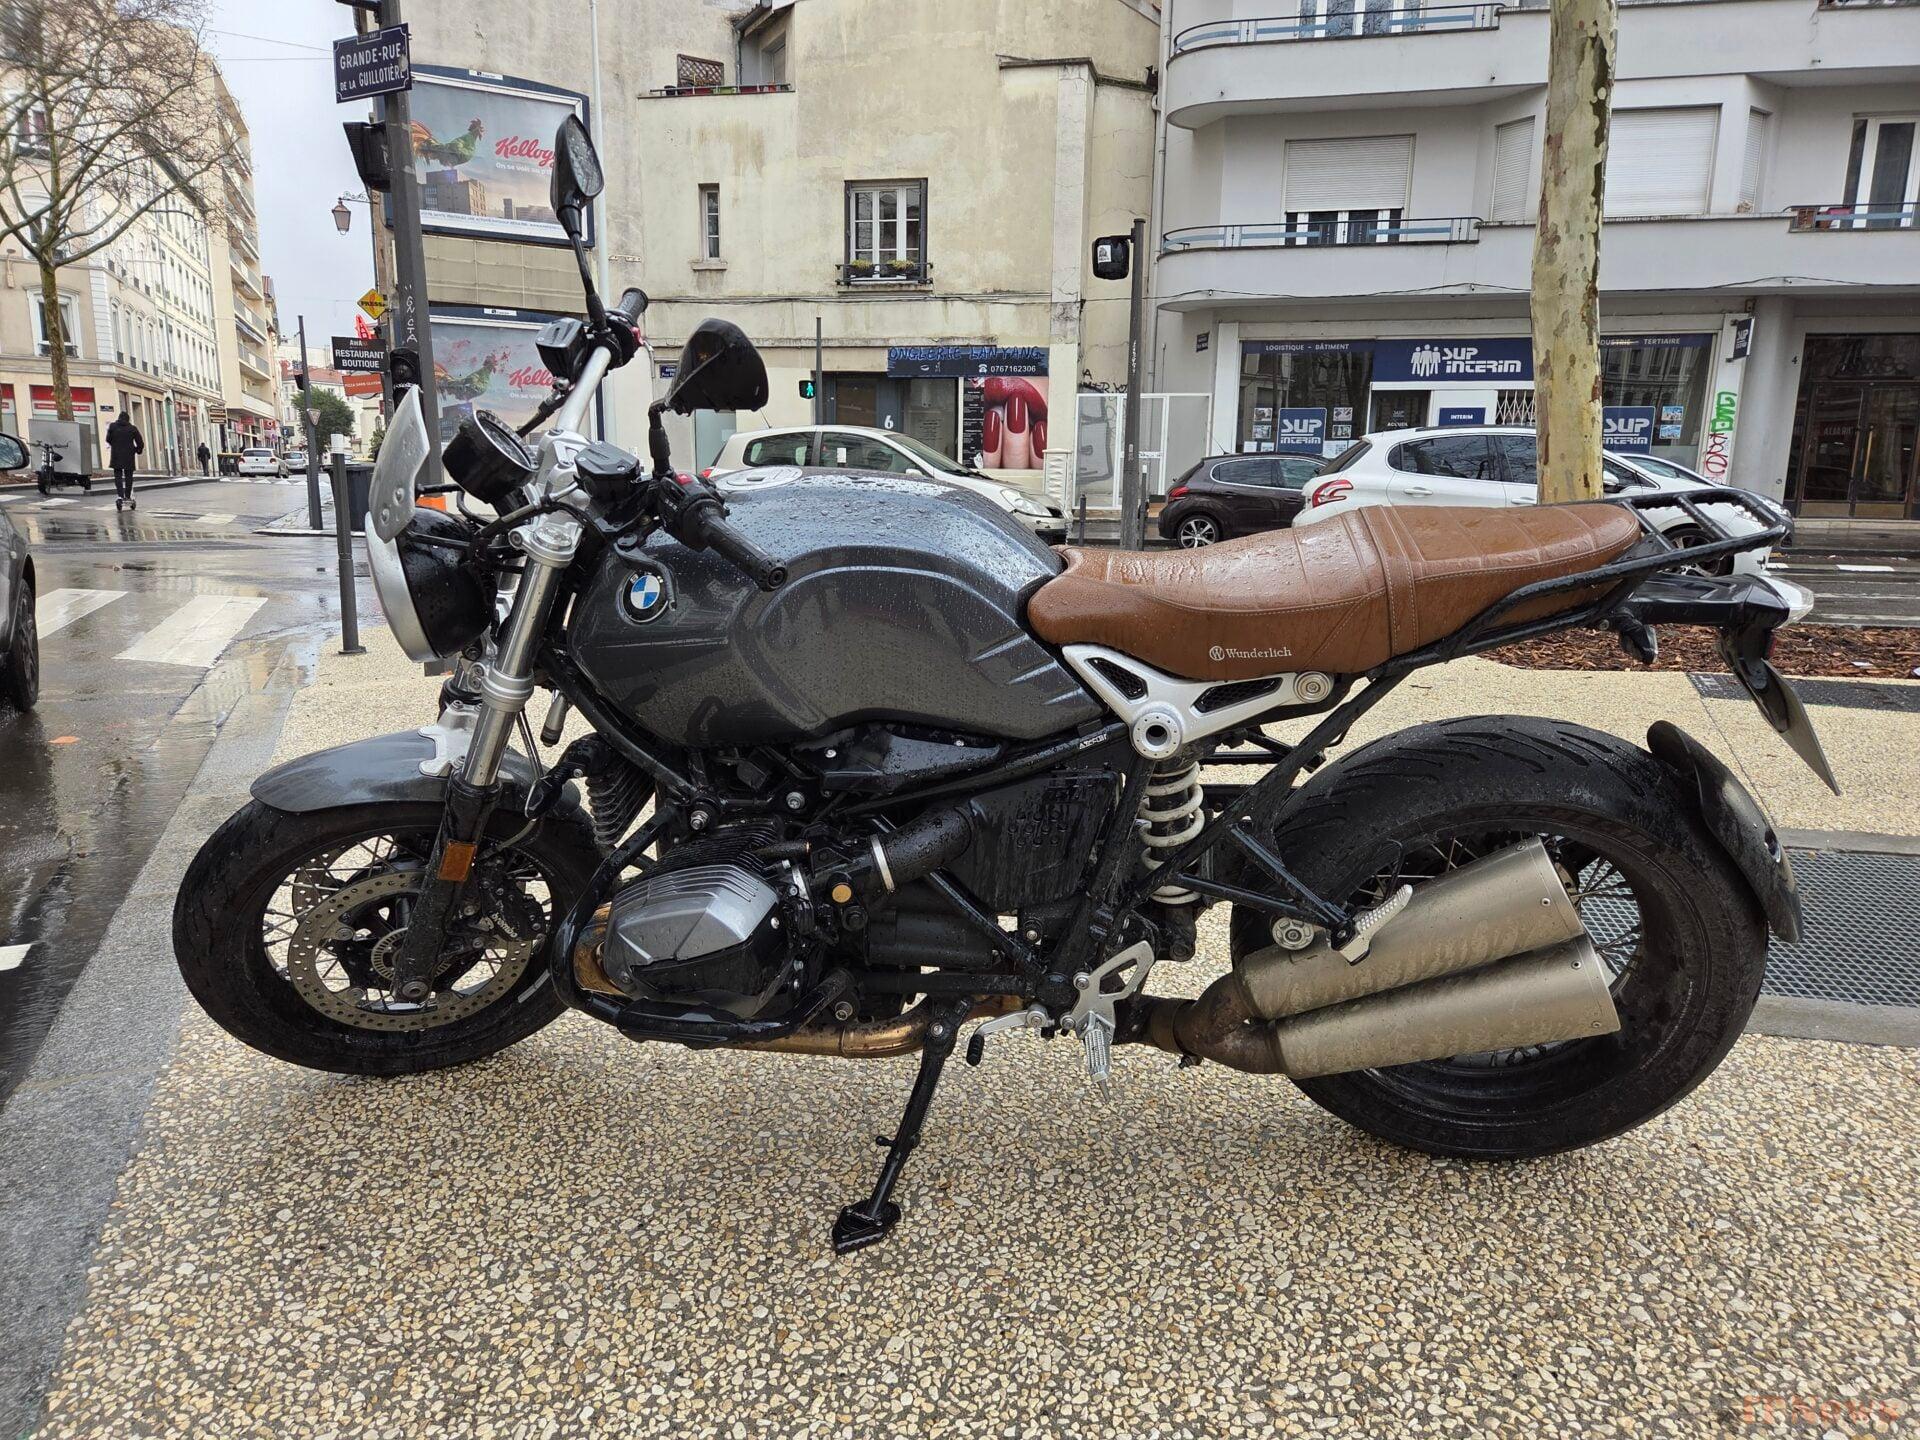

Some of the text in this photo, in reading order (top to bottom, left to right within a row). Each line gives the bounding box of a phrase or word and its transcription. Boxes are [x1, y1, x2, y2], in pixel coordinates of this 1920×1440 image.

[340, 42, 402, 70] GRANDE-RUE
[340, 81, 347, 91] DE
[348, 79, 357, 90] LA
[1265, 342, 1350, 352] LOGISTIQUE BÂTIMENT
[1643, 337, 1681, 345] TERTIAIRE
[335, 349, 385, 360] RESTAURANT
[888, 346, 962, 361] ONGLERIE
[1442, 347, 1478, 360] SUP
[341, 359, 380, 369] BOUTIQUE
[1791, 355, 1798, 365] 4
[990, 365, 1036, 373] 0767162306
[884, 414, 894, 429] 6
[1281, 419, 1322, 433] SUP
[1603, 418, 1650, 433] SUP
[1226, 646, 1292, 659] Wunderlich
